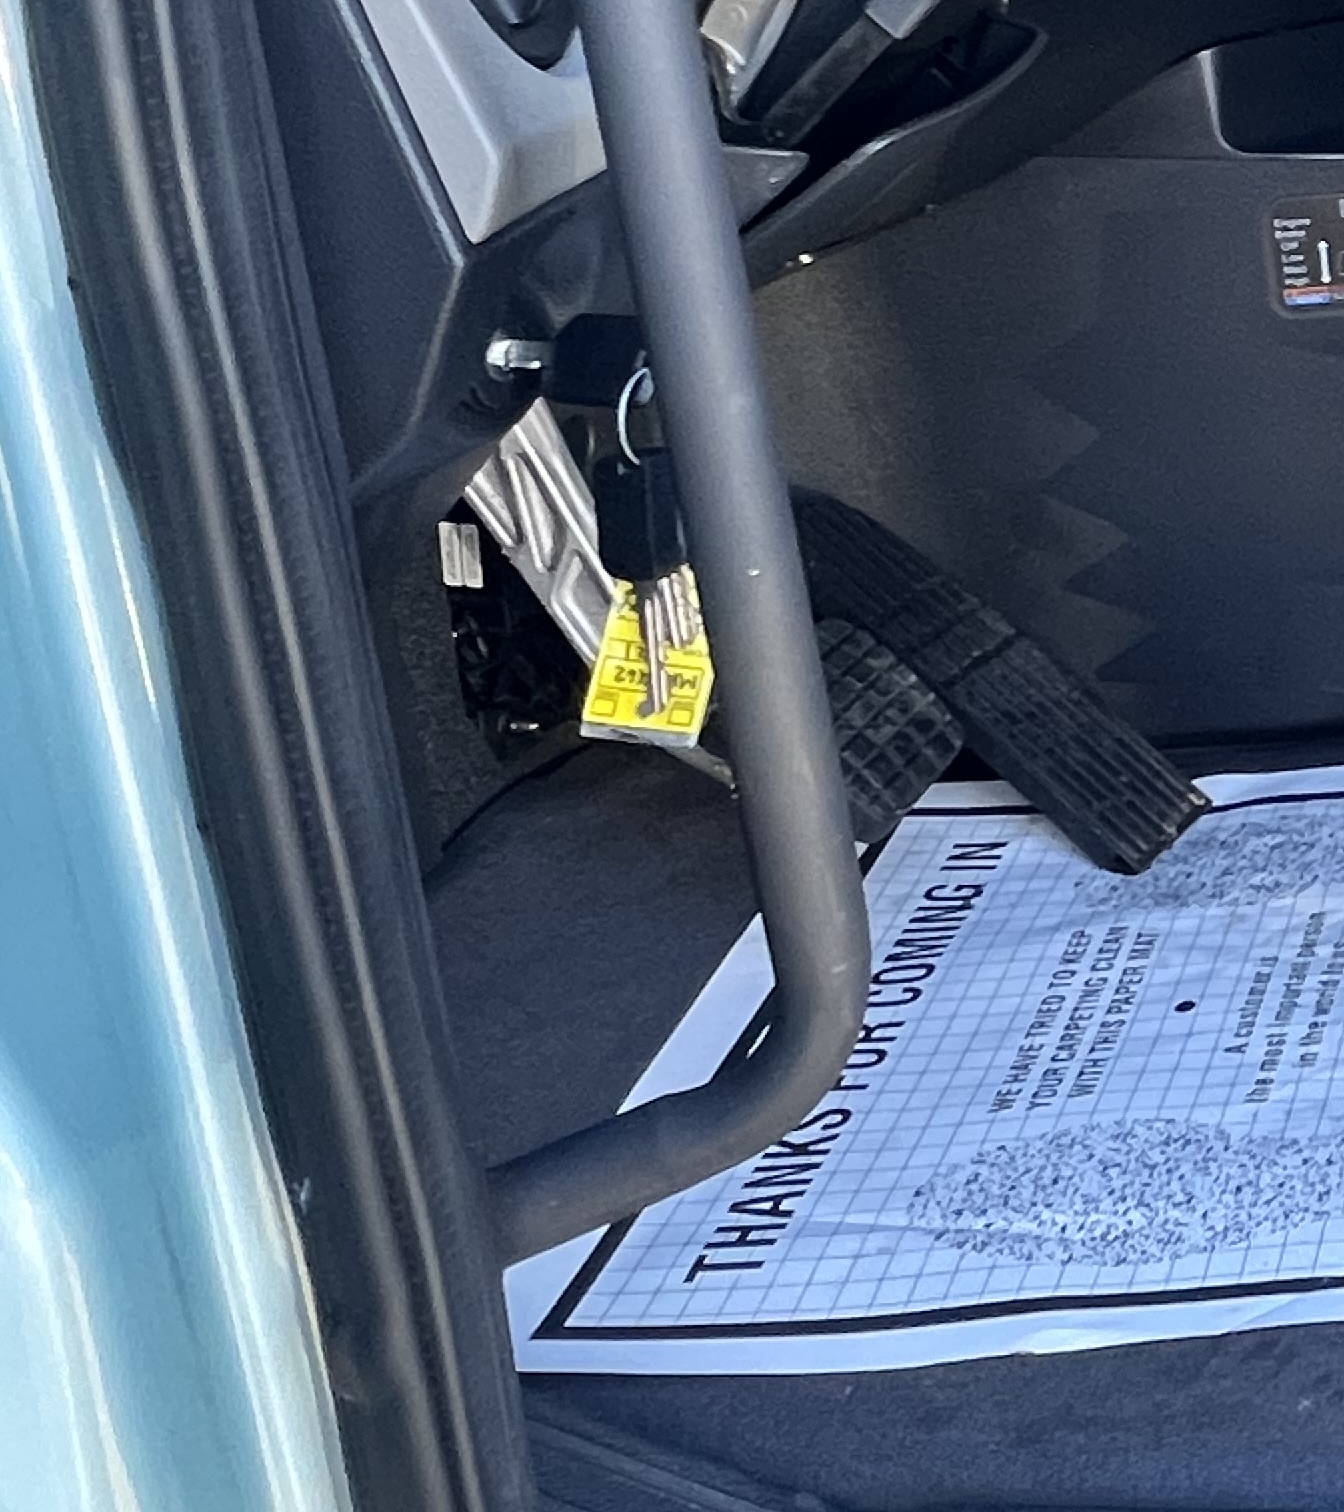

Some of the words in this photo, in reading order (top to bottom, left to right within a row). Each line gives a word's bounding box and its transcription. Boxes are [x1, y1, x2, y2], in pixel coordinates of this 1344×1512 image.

[1058, 929, 1093, 966] KEEP
[1126, 931, 1160, 962] MAT
[1296, 911, 1326, 959] person
[1047, 969, 1078, 990] TO
[1104, 964, 1148, 1016] PAPER
[1266, 961, 1313, 1028] important
[1310, 979, 1341, 1016] world
[1024, 994, 1066, 1039] TRIED
[1026, 1067, 1067, 1112] YOUR
[1050, 976, 1109, 1063] CARPETING
[1089, 926, 1130, 972] CLEAN
[1233, 973, 1272, 1038] customer
[1087, 1018, 1127, 1055] THIS
[1222, 1042, 1250, 1054] A
[1257, 1032, 1288, 1072] most
[1298, 1020, 1328, 1047] the
[683, 1108, 852, 1283] THANKS
[865, 883, 985, 1009] COMING
[940, 841, 1008, 872] IN
[1002, 1043, 1045, 1085] HAVE
[1066, 1057, 1110, 1099] WITH
[1292, 1051, 1320, 1068] in
[987, 1088, 1023, 1113] WE
[1243, 1078, 1275, 1104] the
